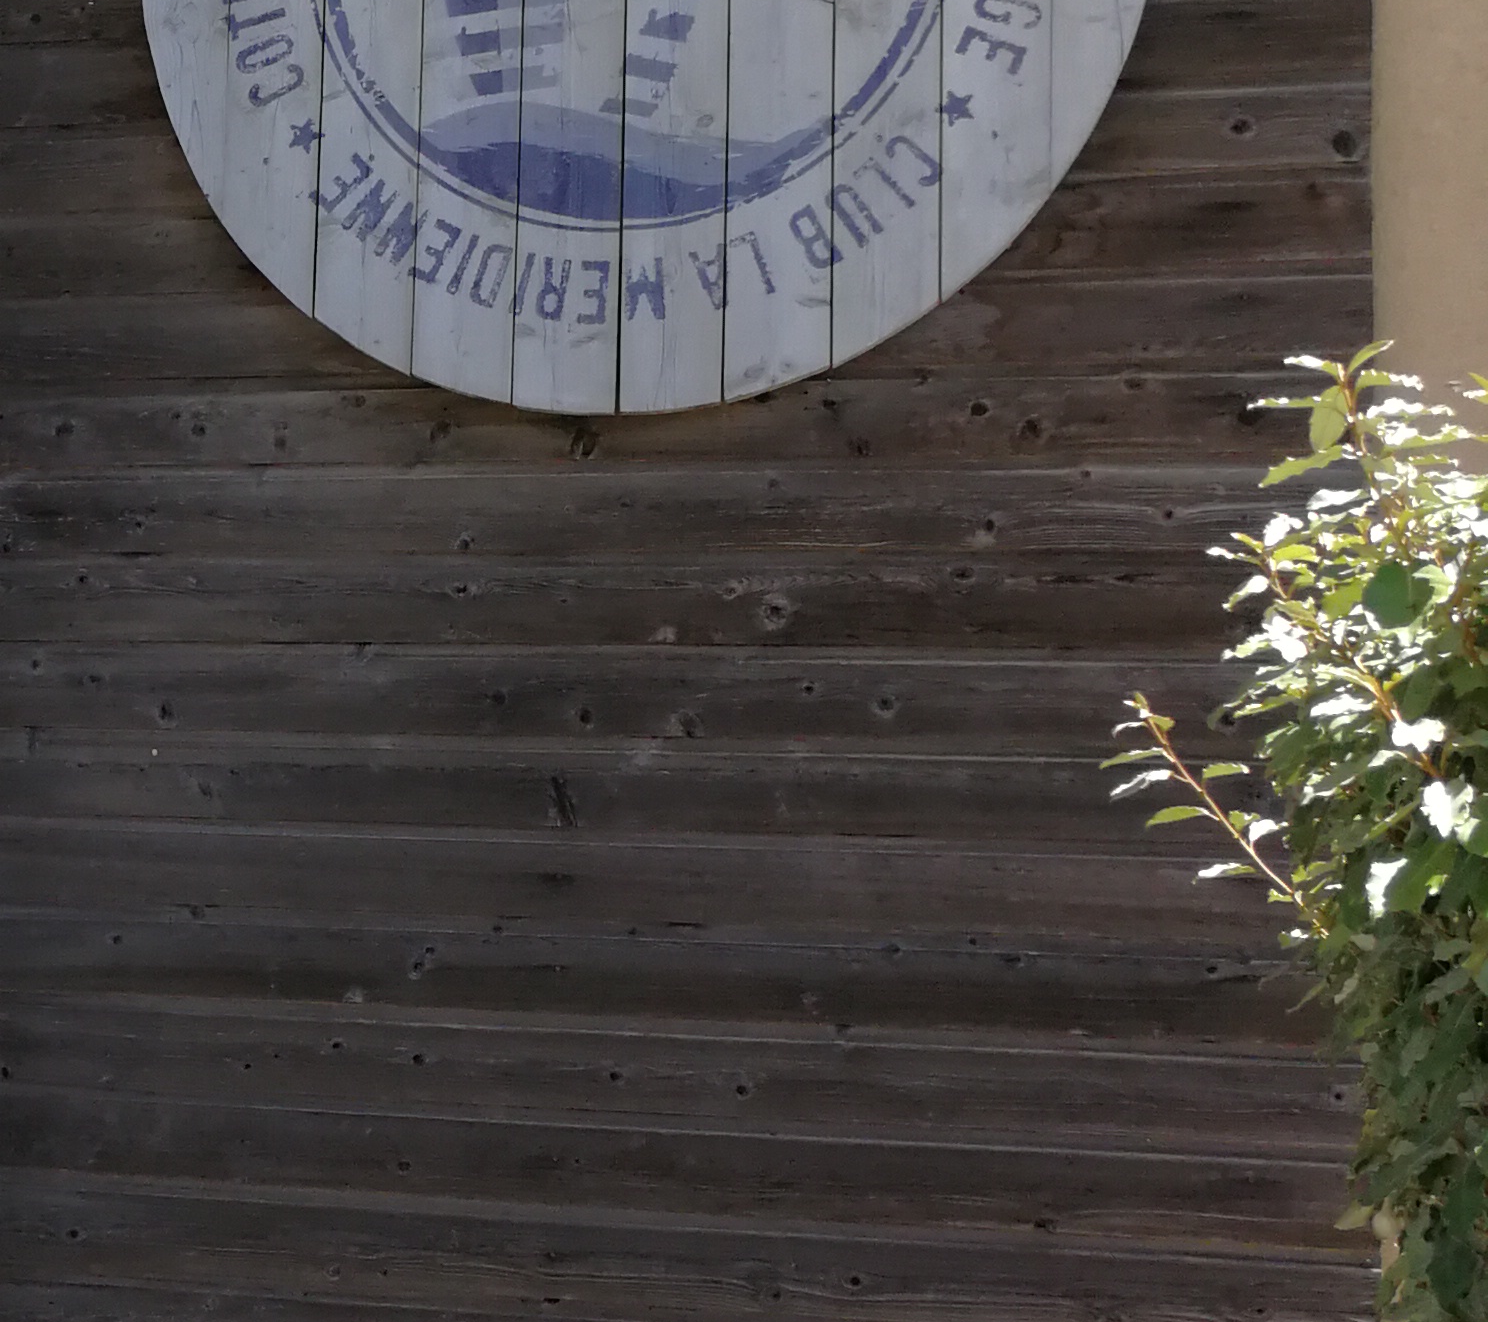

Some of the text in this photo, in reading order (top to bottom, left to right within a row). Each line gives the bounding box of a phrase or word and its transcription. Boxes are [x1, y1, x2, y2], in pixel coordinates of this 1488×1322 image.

[308, 134, 944, 325] CLUB LA MERIDIENNE
